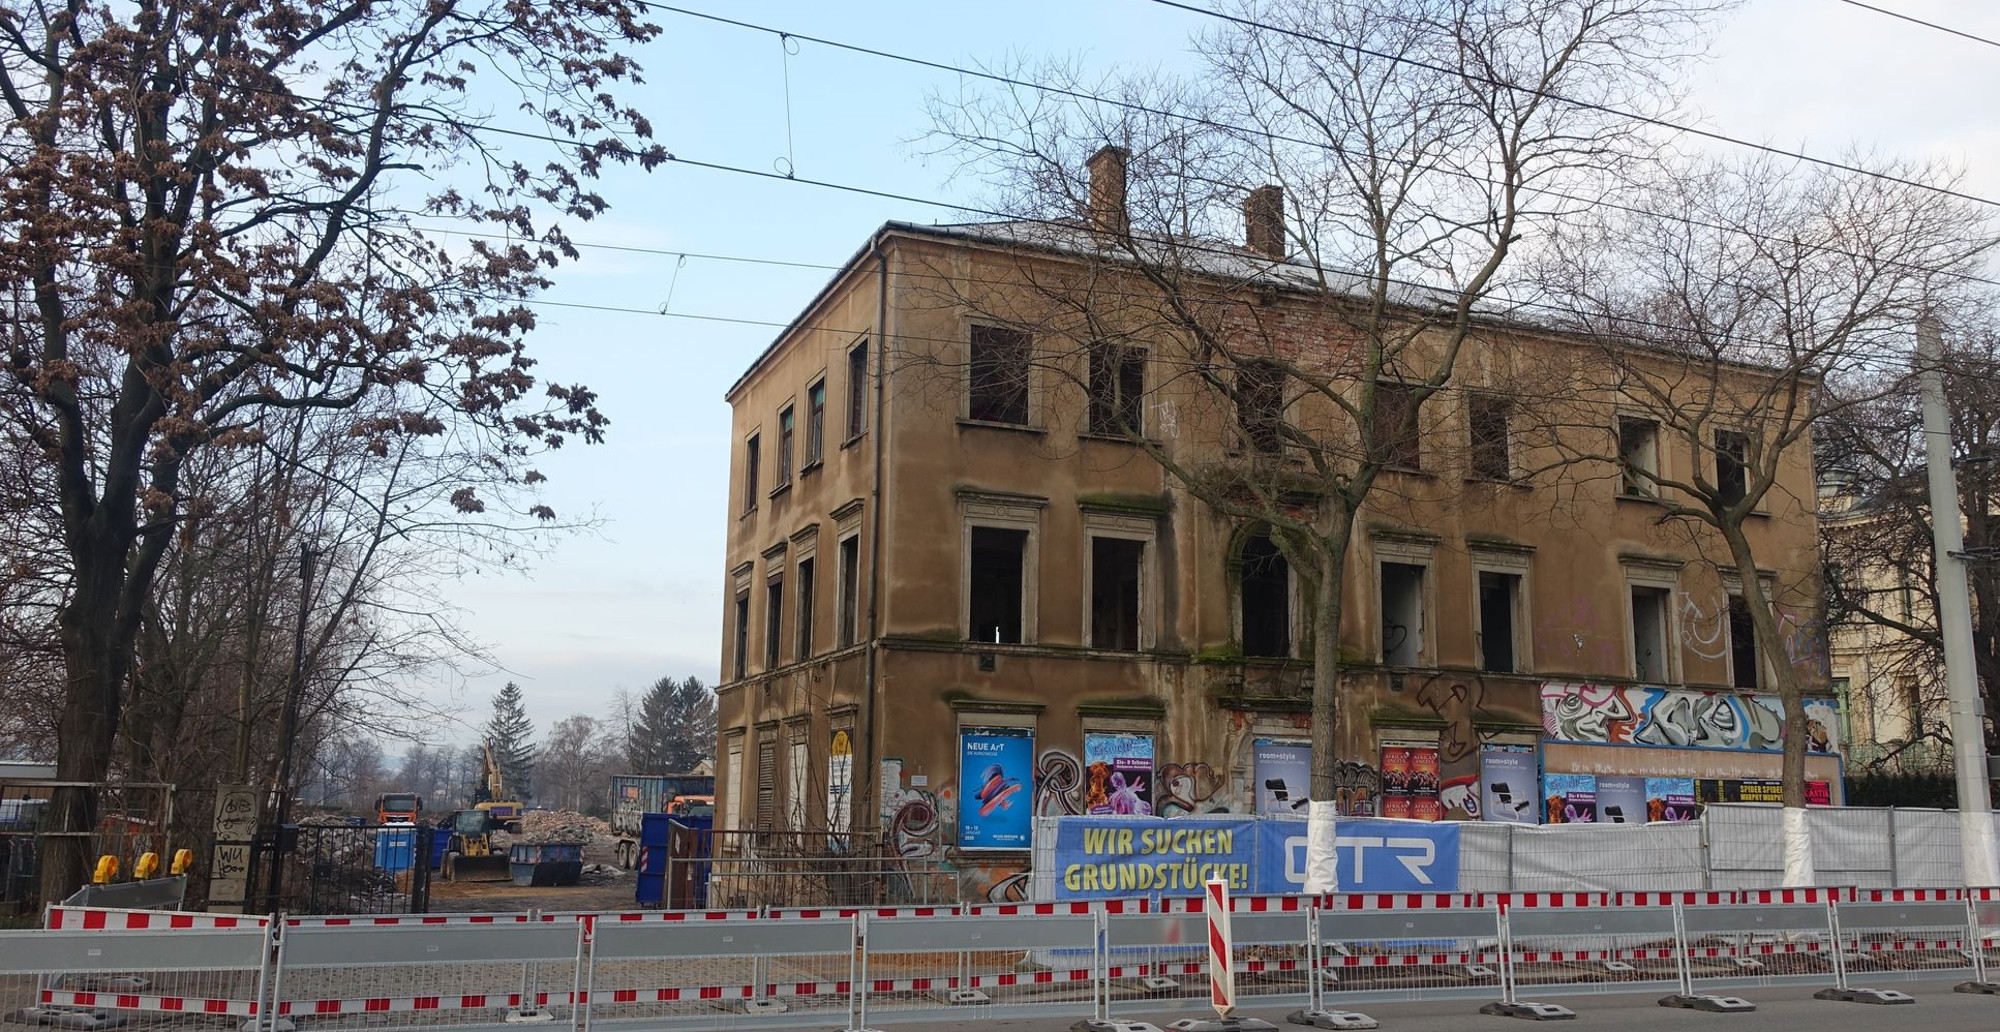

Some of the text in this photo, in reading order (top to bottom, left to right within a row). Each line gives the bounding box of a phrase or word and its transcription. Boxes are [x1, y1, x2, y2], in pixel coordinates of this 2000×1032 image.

[967, 742, 1004, 751] NEUE ArT
[1259, 753, 1296, 761] room+style
[1485, 758, 1519, 766] room+style
[1740, 785, 1761, 793] SPIDER
[1740, 793, 1762, 801] MURPHY
[1084, 828, 1233, 855] WIR SUCHEN
[1064, 857, 1248, 891] GRUNDSTÜCKE!
